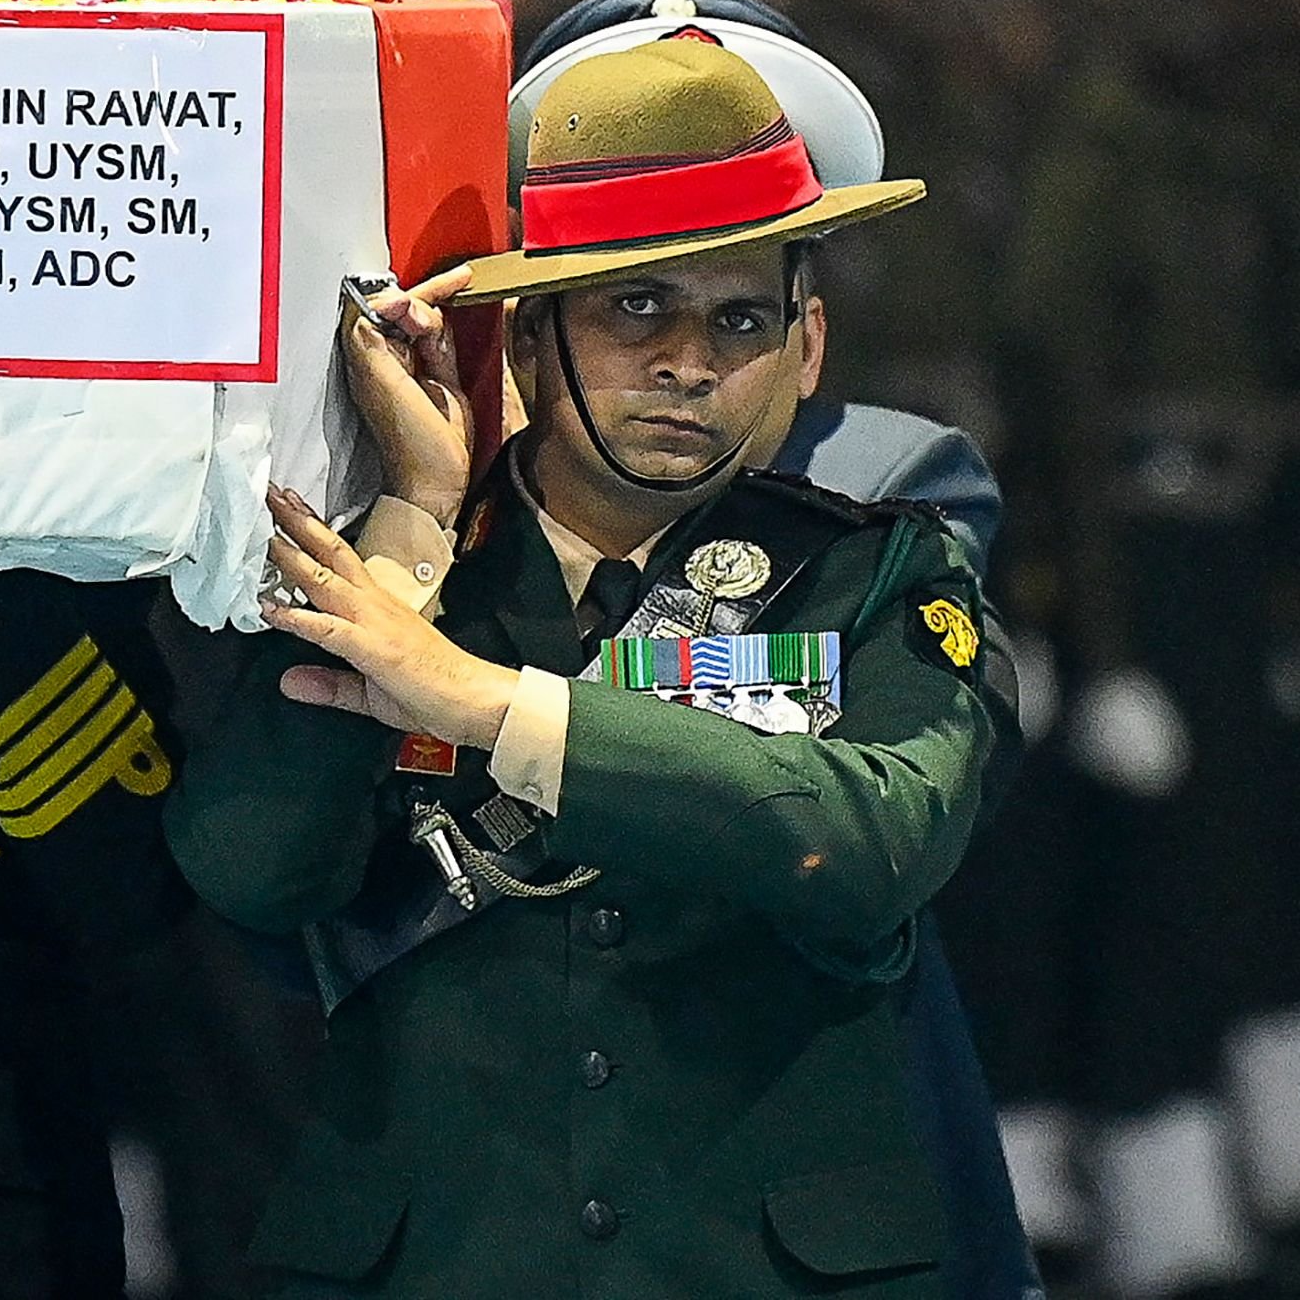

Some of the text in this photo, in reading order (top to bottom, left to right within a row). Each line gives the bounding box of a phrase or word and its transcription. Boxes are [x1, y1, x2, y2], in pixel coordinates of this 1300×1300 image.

[65, 89, 242, 136] RAWAT,
[28, 142, 179, 189] UYSM,
[127, 197, 210, 243] SM,
[31, 249, 136, 288] ADC
